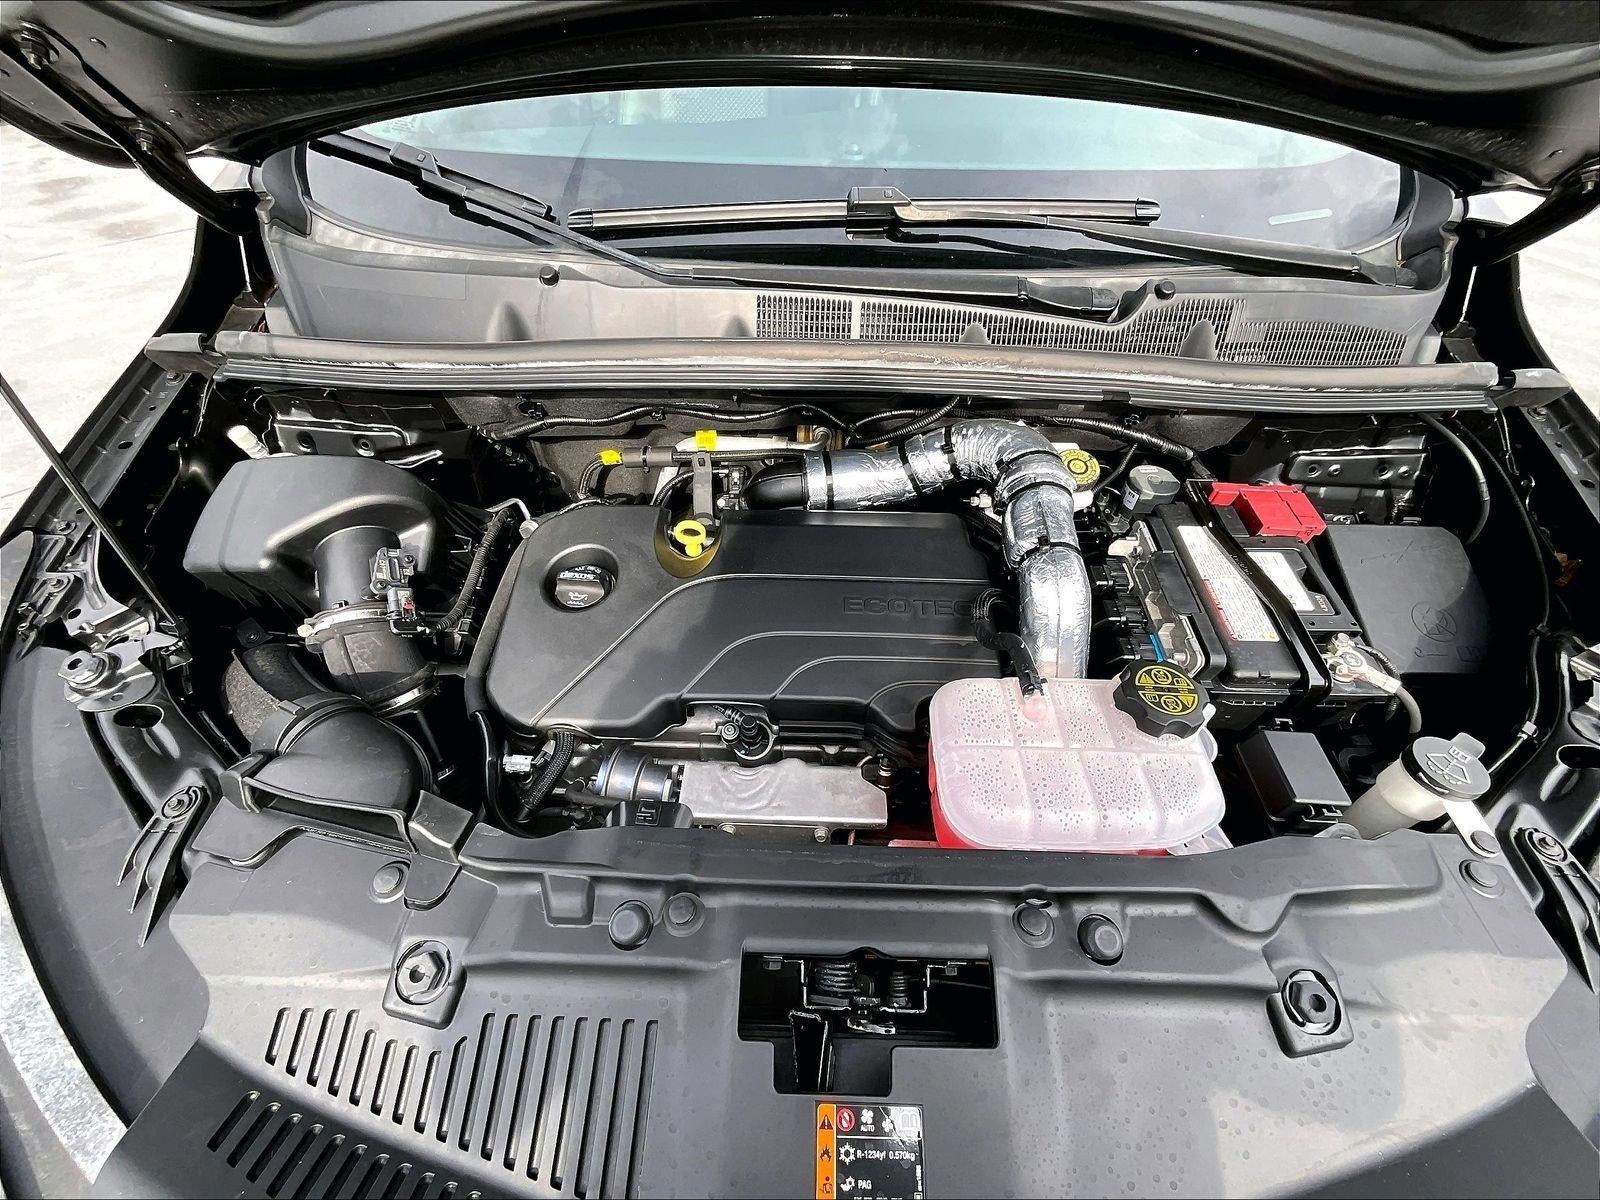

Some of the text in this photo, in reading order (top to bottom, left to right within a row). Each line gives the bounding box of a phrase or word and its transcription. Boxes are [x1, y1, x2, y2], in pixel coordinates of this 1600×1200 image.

[842, 597, 974, 617] ECOTEC
[857, 1150, 916, 1161] R-1234yf 0.570kg
[857, 1179, 872, 1190] PAG
